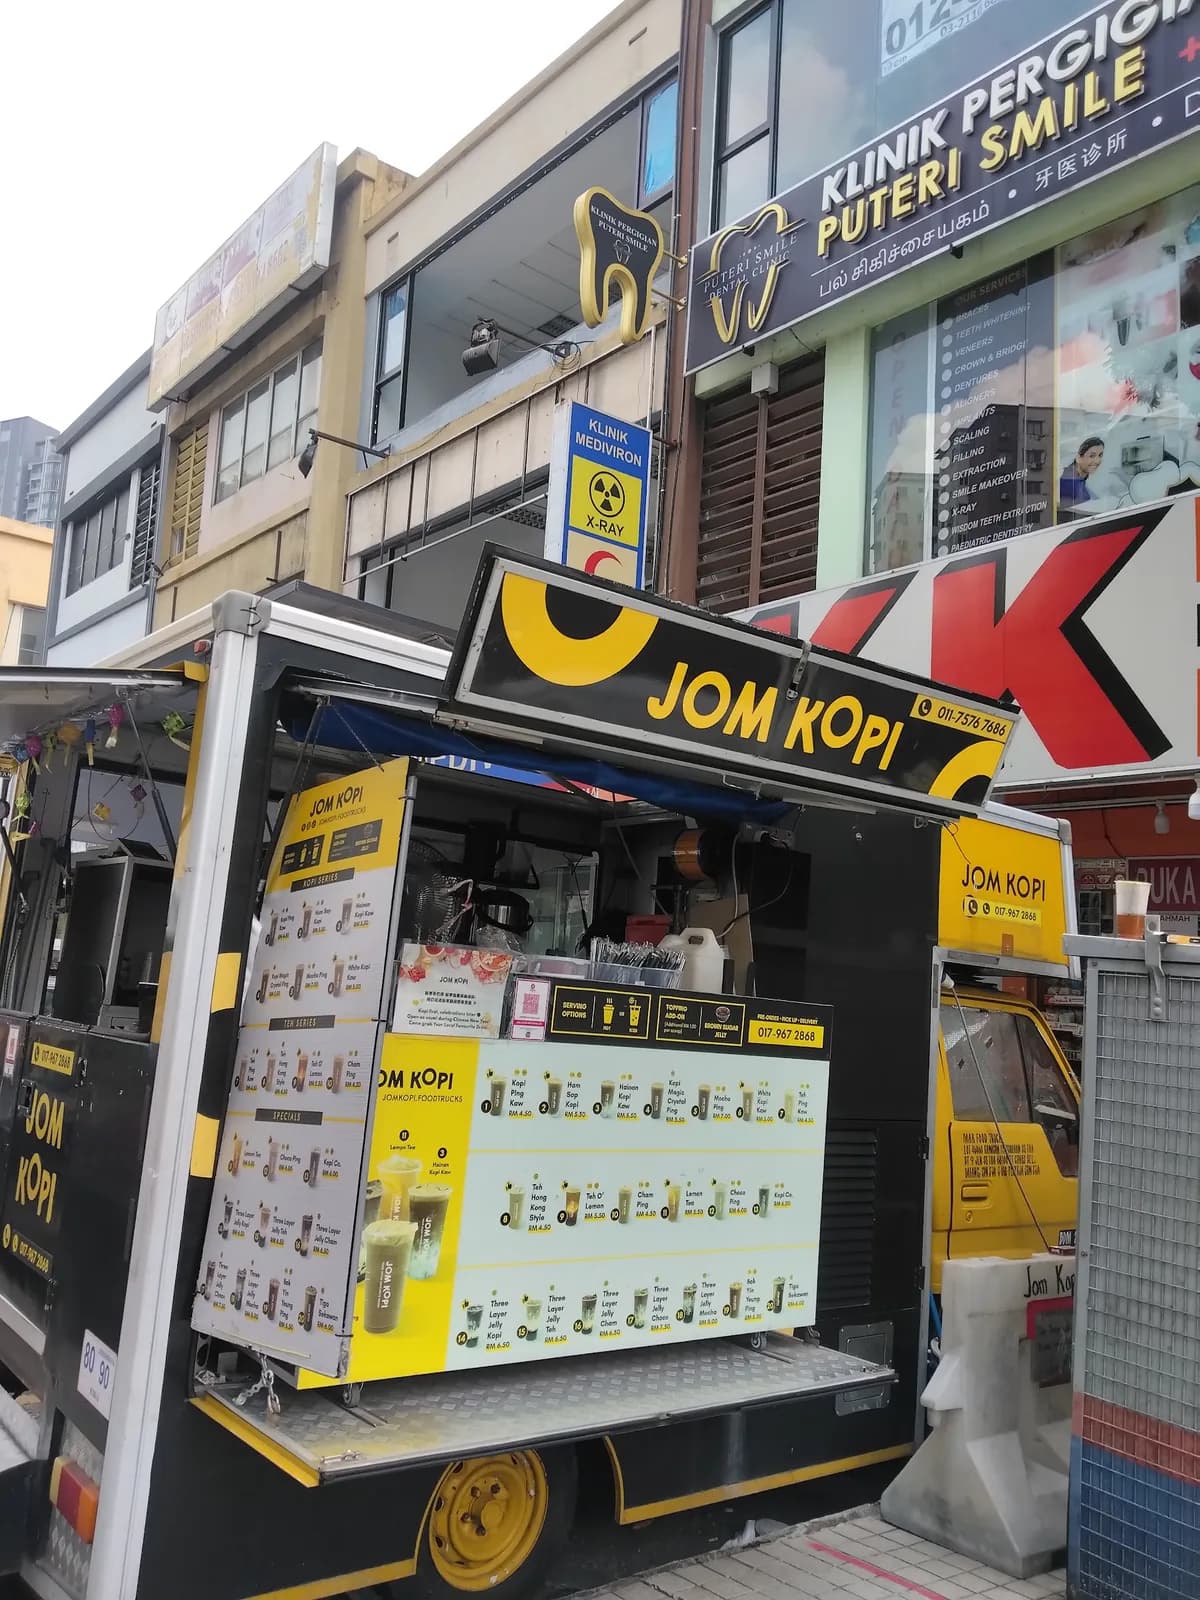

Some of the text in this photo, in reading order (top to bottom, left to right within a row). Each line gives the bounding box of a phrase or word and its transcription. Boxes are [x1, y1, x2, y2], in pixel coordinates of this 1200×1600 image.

[821, 0, 1196, 212] KLINIK PERGIGI
[818, 45, 1146, 258] PUTERI SMILE
[1034, 128, 1128, 192] 牙医诊所
[591, 205, 657, 247] KLINIK PERGIGIAN
[598, 220, 648, 253] PUTERI SMILE
[703, 233, 799, 293] PUTERI SMILE
[819, 269, 848, 298] பல்
[956, 302, 990, 322] BRACES
[956, 323, 981, 339] TEETH
[955, 336, 993, 357] VENEERS
[955, 357, 986, 375] CROWN
[988, 352, 993, 362] &
[954, 369, 999, 392] DENTURES
[953, 388, 996, 409] ALIGNERS
[589, 419, 628, 444] KLINIK
[953, 426, 990, 445] SCALING
[576, 432, 642, 467] MEDIVIRON
[953, 446, 985, 463] FILLING
[952, 457, 1006, 481] EXTRACTION
[952, 469, 1028, 499] SMILE MAKEOVER
[951, 501, 1047, 535] WISDOM TEETH EXTRACTION
[952, 503, 977, 517] X-RAY
[586, 514, 624, 537] X-RAY
[951, 523, 1034, 553] PAEDIATRIC DENTISTRY
[647, 662, 904, 771] JOM KOPI
[937, 705, 1006, 736] 011-7576 7686
[310, 786, 364, 817] JOM KOPI
[303, 873, 338, 888] KOPI SERIES
[962, 863, 1001, 893] JOM
[1007, 873, 1046, 902] KOPI
[995, 906, 1036, 921] 017-967 2868
[296, 1018, 317, 1027] SERIES
[562, 1011, 587, 1019] OPTIONS
[758, 1028, 815, 1041] 017-967 2868
[378, 1067, 454, 1090] OM KOPI
[511, 1080, 526, 1088] Kopi
[567, 1081, 581, 1089] Ham
[382, 1094, 463, 1103] JOMKOPI.FOODTRUCKS
[511, 1090, 524, 1099] Ping
[667, 1097, 686, 1105] Crystal
[565, 1101, 579, 1110] Kopi
[25, 1088, 64, 1149] JOM
[273, 1112, 302, 1121] SPECIALS
[15, 1152, 57, 1223] KOPI
[531, 1194, 547, 1202] Hong
[529, 1214, 545, 1222] Style
[530, 1204, 546, 1212] Kong
[381, 1261, 393, 1309] JOM KOPI
[1024, 1265, 1048, 1298] Jom
[489, 1311, 507, 1319] Layer
[546, 1315, 561, 1324] Jelly
[547, 1305, 565, 1313] Layer
[601, 1311, 615, 1319] Jelly
[652, 1305, 664, 1313] Jelly
[488, 1321, 503, 1330] Jelly
[487, 1332, 502, 1341] Kopi
[84, 1342, 96, 1373] 80
[99, 1360, 110, 1389] 90
